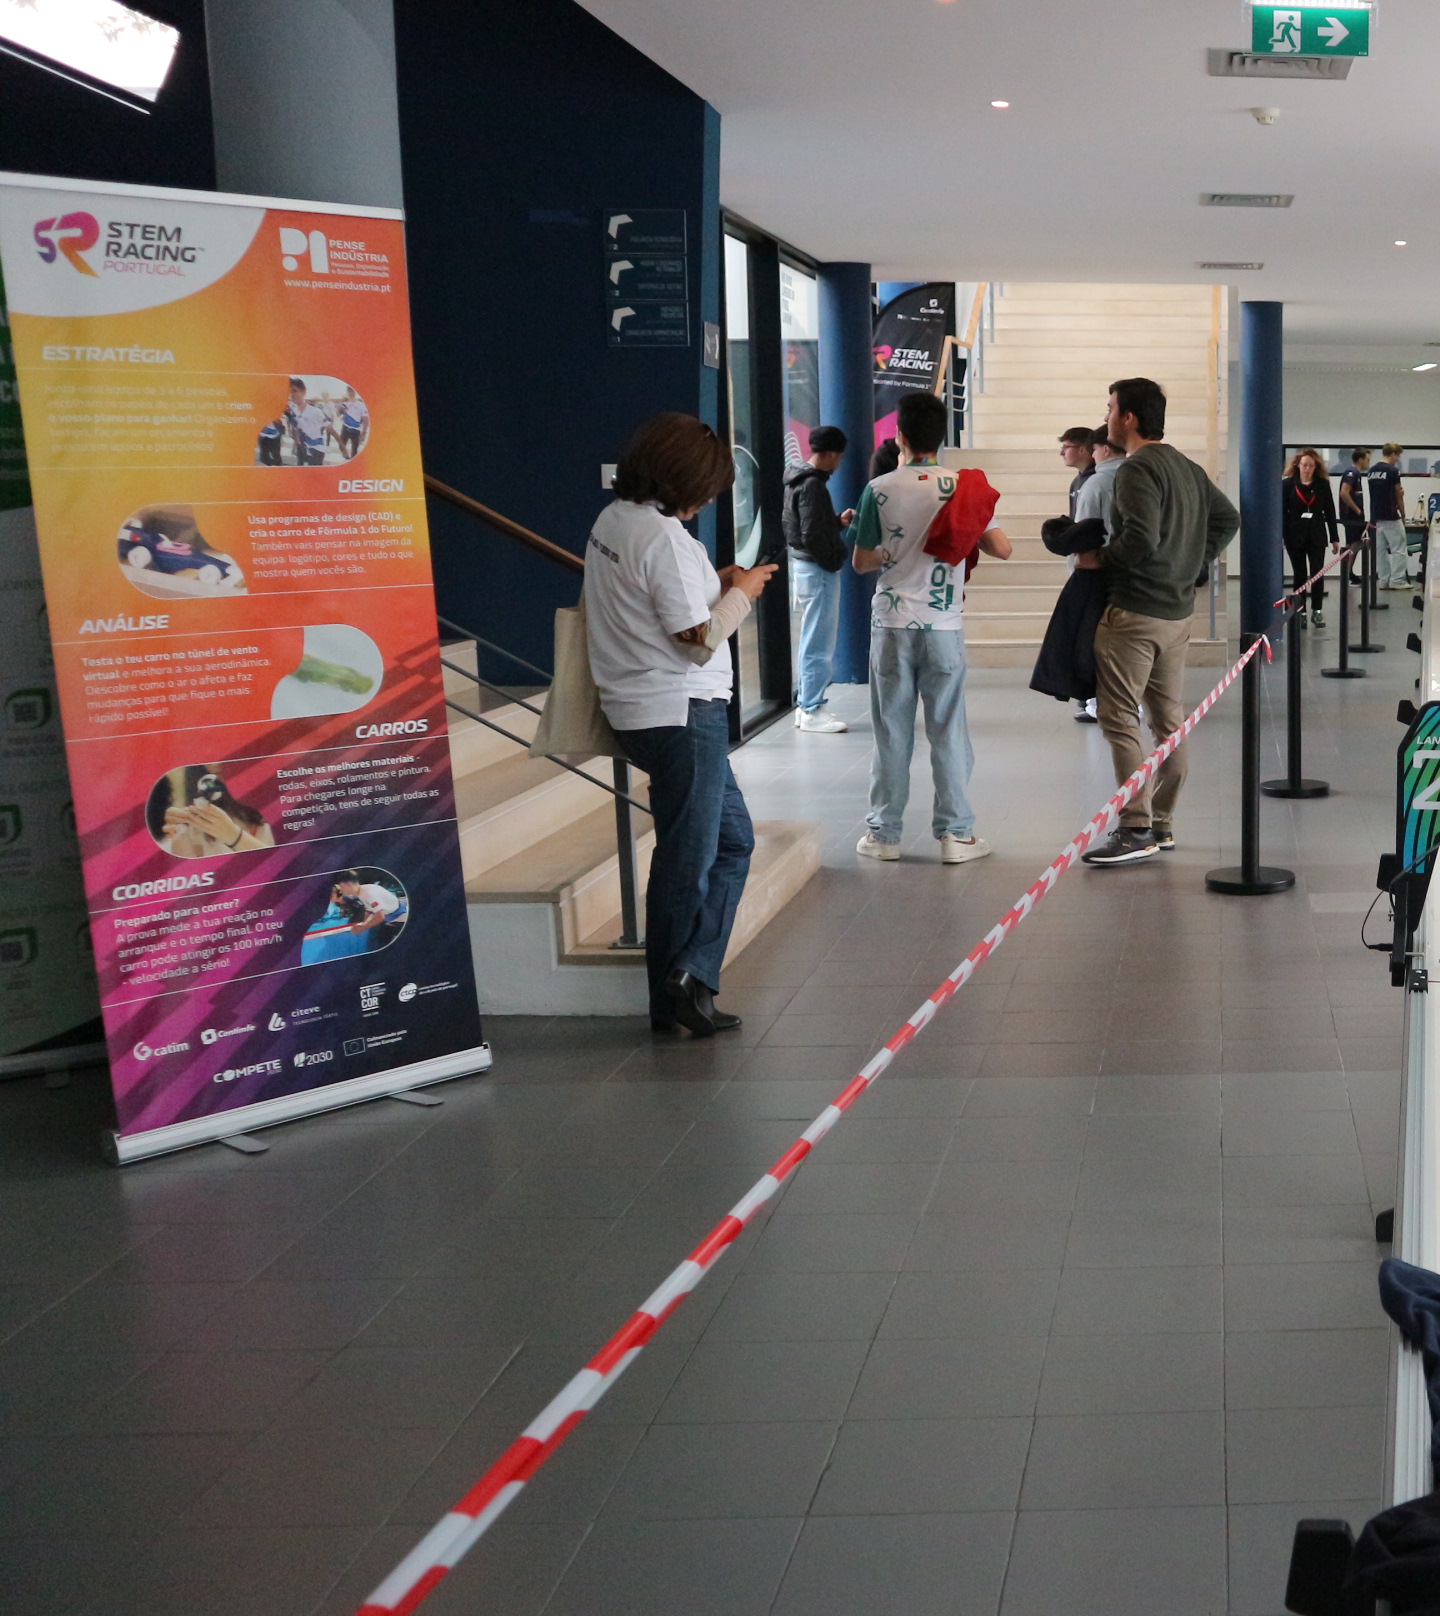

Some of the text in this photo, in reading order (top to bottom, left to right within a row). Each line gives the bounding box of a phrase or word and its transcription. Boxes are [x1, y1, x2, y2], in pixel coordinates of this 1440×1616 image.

[107, 222, 182, 242] STEM
[329, 240, 365, 250] PENSE
[104, 260, 186, 276] PORTUGAL
[284, 279, 391, 292] www.penseindustria.pt
[43, 345, 175, 363] ESTRATÉGIA
[893, 348, 929, 360] STEM
[889, 358, 933, 371] RACING
[338, 480, 404, 492] DESIGN
[1430, 499, 1437, 509] 2
[248, 516, 266, 524] Usa
[268, 515, 320, 525] programas
[322, 514, 333, 522] de
[336, 513, 366, 523] design
[369, 512, 393, 522] (CAD)
[249, 529, 267, 537] cria
[318, 526, 358, 535] Fórmula
[368, 525, 379, 533] do
[382, 524, 413, 533] Futuro!
[79, 613, 169, 634] ANÁLISE
[355, 718, 428, 738] CARROS
[277, 767, 313, 778] Escolhe
[328, 760, 370, 772] melhores
[372, 755, 415, 766] materiais
[279, 781, 307, 791] rodas,
[310, 778, 335, 787] eixos,
[337, 771, 389, 783] rolamentos
[398, 766, 431, 777] pintura.
[280, 795, 302, 804] Para
[304, 790, 346, 801] chegares
[348, 786, 373, 795] longe
[282, 803, 337, 817] competição,
[339, 800, 359, 809] tens
[361, 798, 372, 806] de
[374, 794, 401, 805] seguir
[403, 791, 427, 800] todas
[283, 818, 315, 830] regras!
[112, 871, 214, 901] CORRIDAS
[114, 899, 240, 928] Preparado para correr?
[116, 934, 124, 943] A
[127, 929, 157, 943] prova
[159, 922, 190, 934] mede
[203, 918, 220, 927] tua
[223, 910, 258, 923] reação
[118, 942, 167, 958] arranque
[189, 932, 224, 944] tempo
[227, 925, 253, 937] final.
[255, 923, 263, 932] O
[266, 921, 283, 930] teu
[120, 935, 282, 972] carro pode atingir os 100 km/h
[129, 967, 189, 985] velocidade
[201, 958, 230, 971] sério!
[360, 988, 370, 998] CT
[361, 997, 378, 1008] COR
[291, 1006, 320, 1018] citeve
[218, 1024, 256, 1038] Centimfe
[154, 1042, 189, 1057] catim
[307, 1051, 333, 1066] 2030
[213, 1059, 282, 1083] COMPETE
